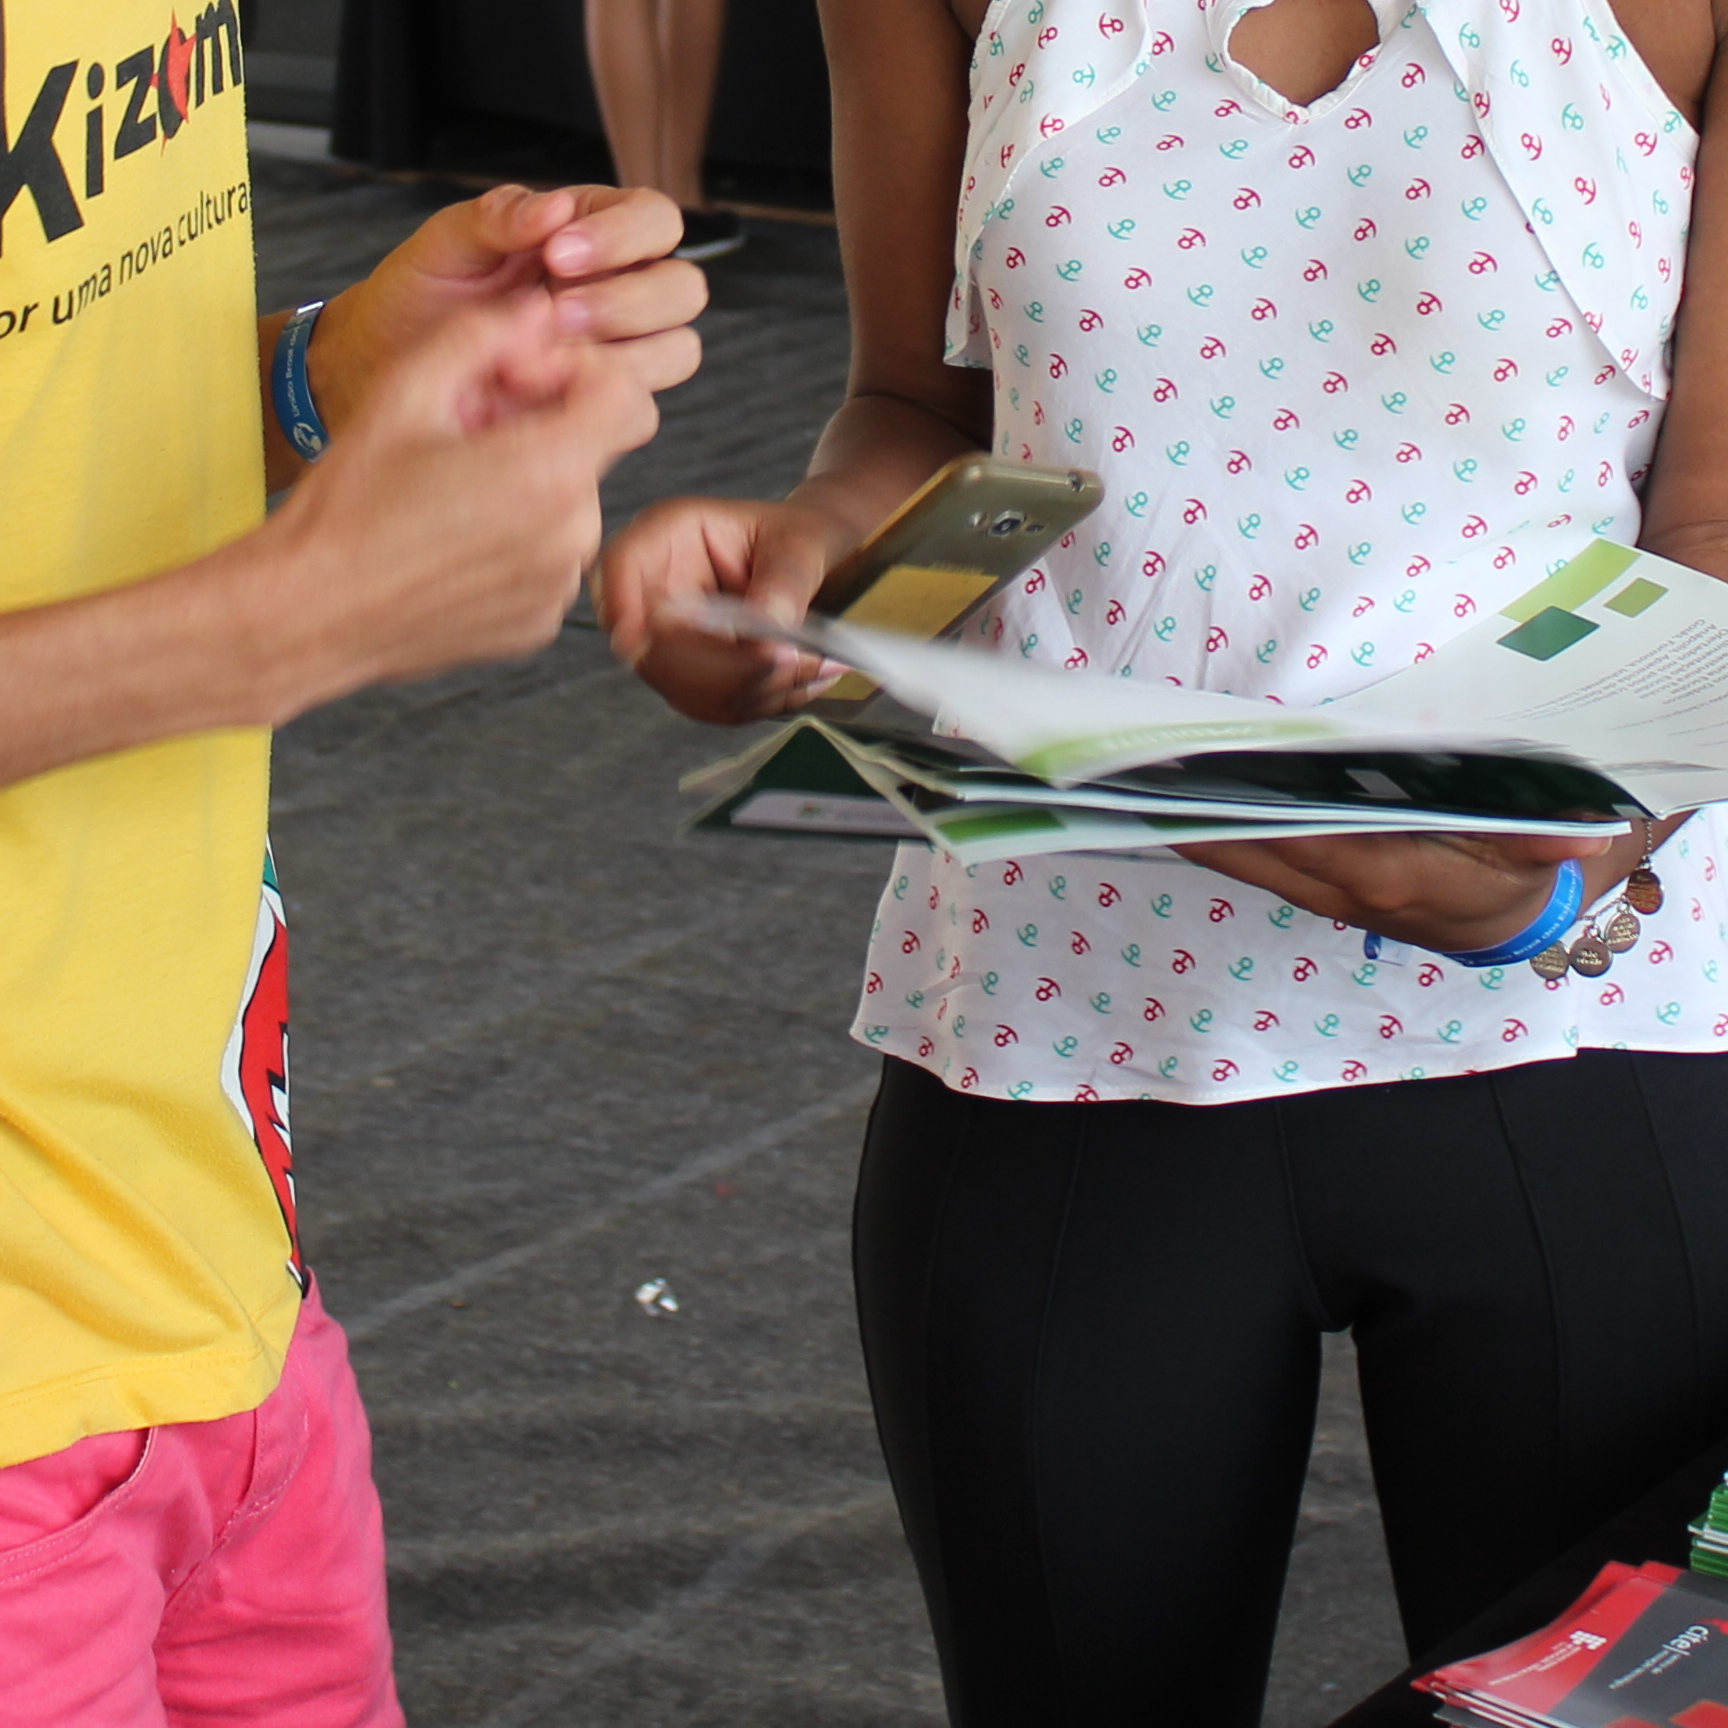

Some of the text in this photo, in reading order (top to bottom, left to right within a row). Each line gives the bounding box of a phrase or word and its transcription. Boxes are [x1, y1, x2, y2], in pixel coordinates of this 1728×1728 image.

[51, 264, 111, 326] uma
[119, 224, 174, 285] nova
[177, 181, 248, 247] cultura
[1672, 619, 1706, 639] Goiás,
[1668, 624, 1717, 654] Anápolis,
[1625, 639, 1676, 667] Formosa,
[1617, 654, 1671, 683] Aparecida
[1657, 660, 1678, 672] nos
[1602, 682, 1617, 692] de
[1626, 671, 1658, 688] polos
[1634, 675, 1672, 694] Escolar
[1671, 676, 1709, 694] Escolar
[1640, 682, 1678, 699] Escolar
[1541, 922, 1561, 939] dos
[1670, 1625, 1709, 1650] cite
